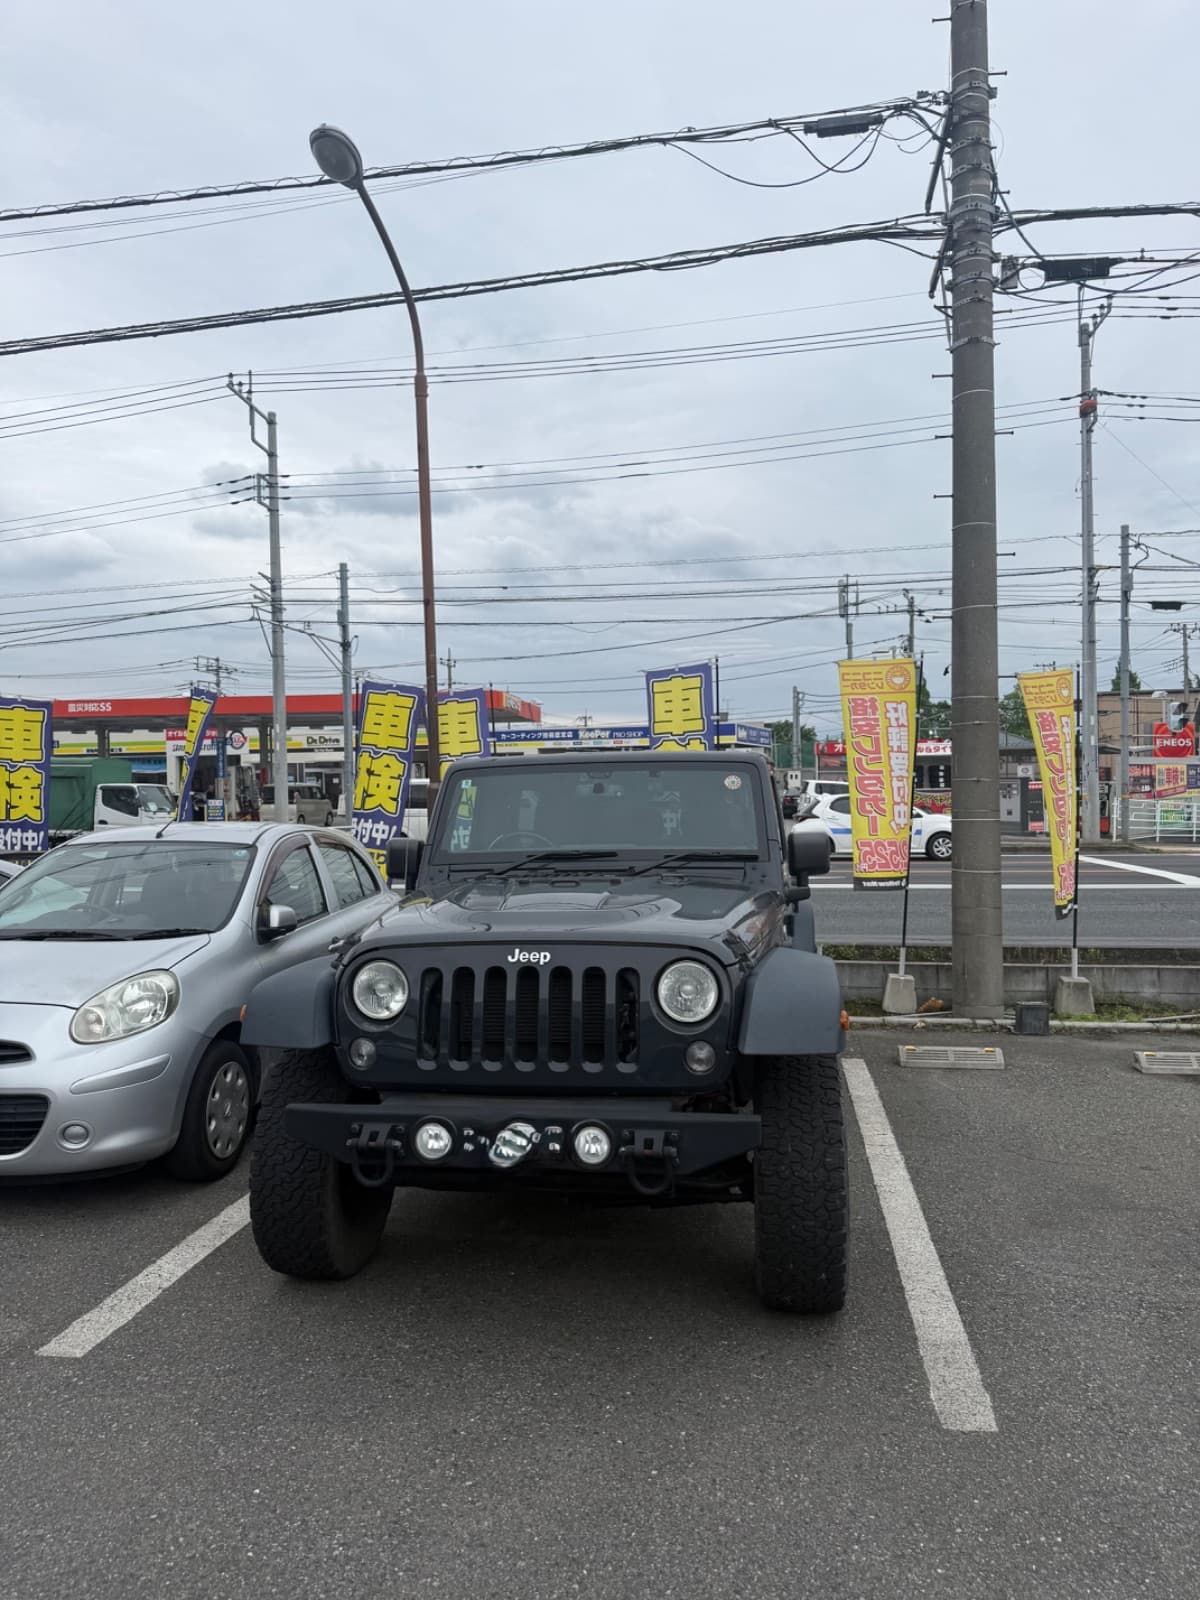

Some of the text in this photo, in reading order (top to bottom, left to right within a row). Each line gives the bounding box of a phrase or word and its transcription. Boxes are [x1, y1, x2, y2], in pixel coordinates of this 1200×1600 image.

[1156, 738, 1192, 748] ENEOS
[353, 690, 418, 816] 車検
[507, 948, 551, 965] Jeep
